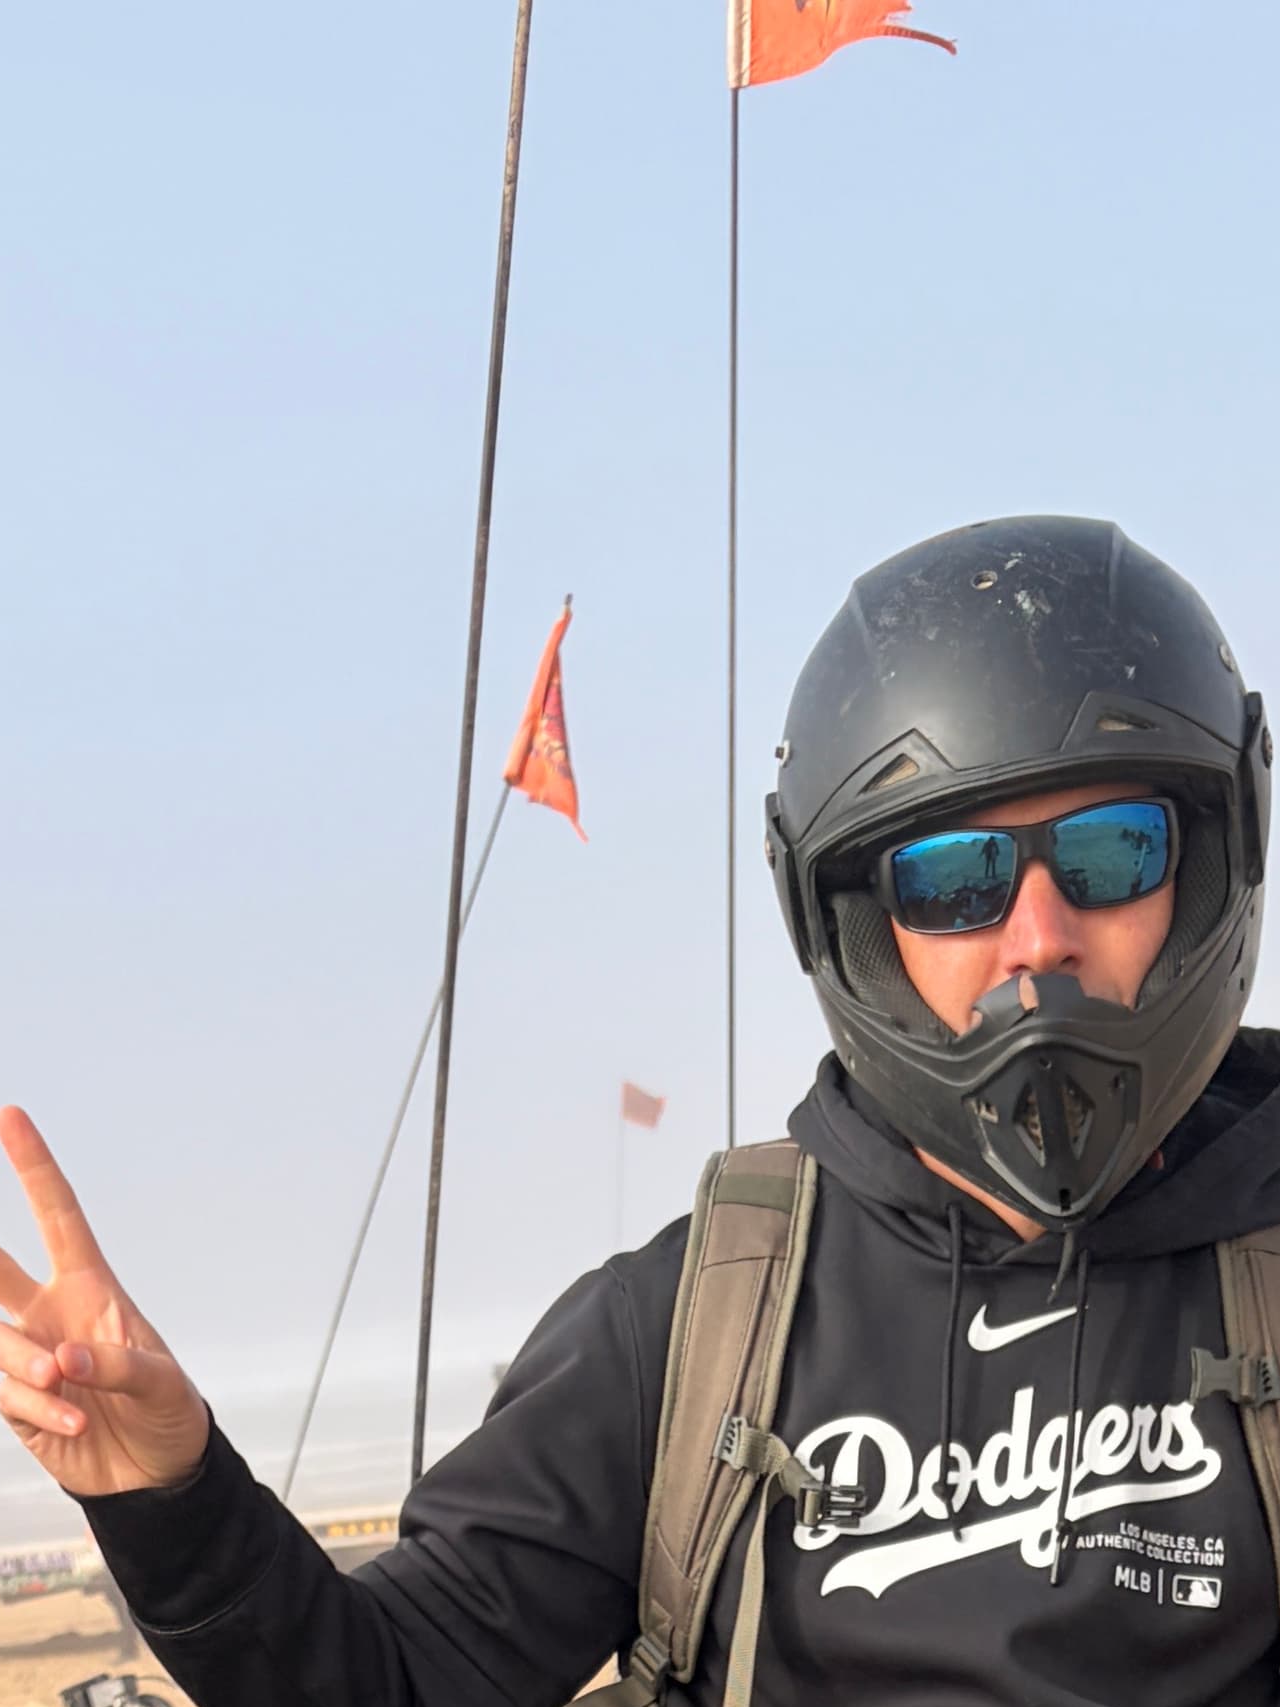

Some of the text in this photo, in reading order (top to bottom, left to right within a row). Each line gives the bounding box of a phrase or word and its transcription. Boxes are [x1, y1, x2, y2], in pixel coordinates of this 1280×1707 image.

[793, 1386, 1220, 1598] Dodgers
[1076, 1534, 1225, 1567] AUTHENTC COLLECTION
[1120, 1521, 1140, 1538] LOS
[1204, 1537, 1225, 1552] CA
[1114, 1565, 1151, 1593] MLB
